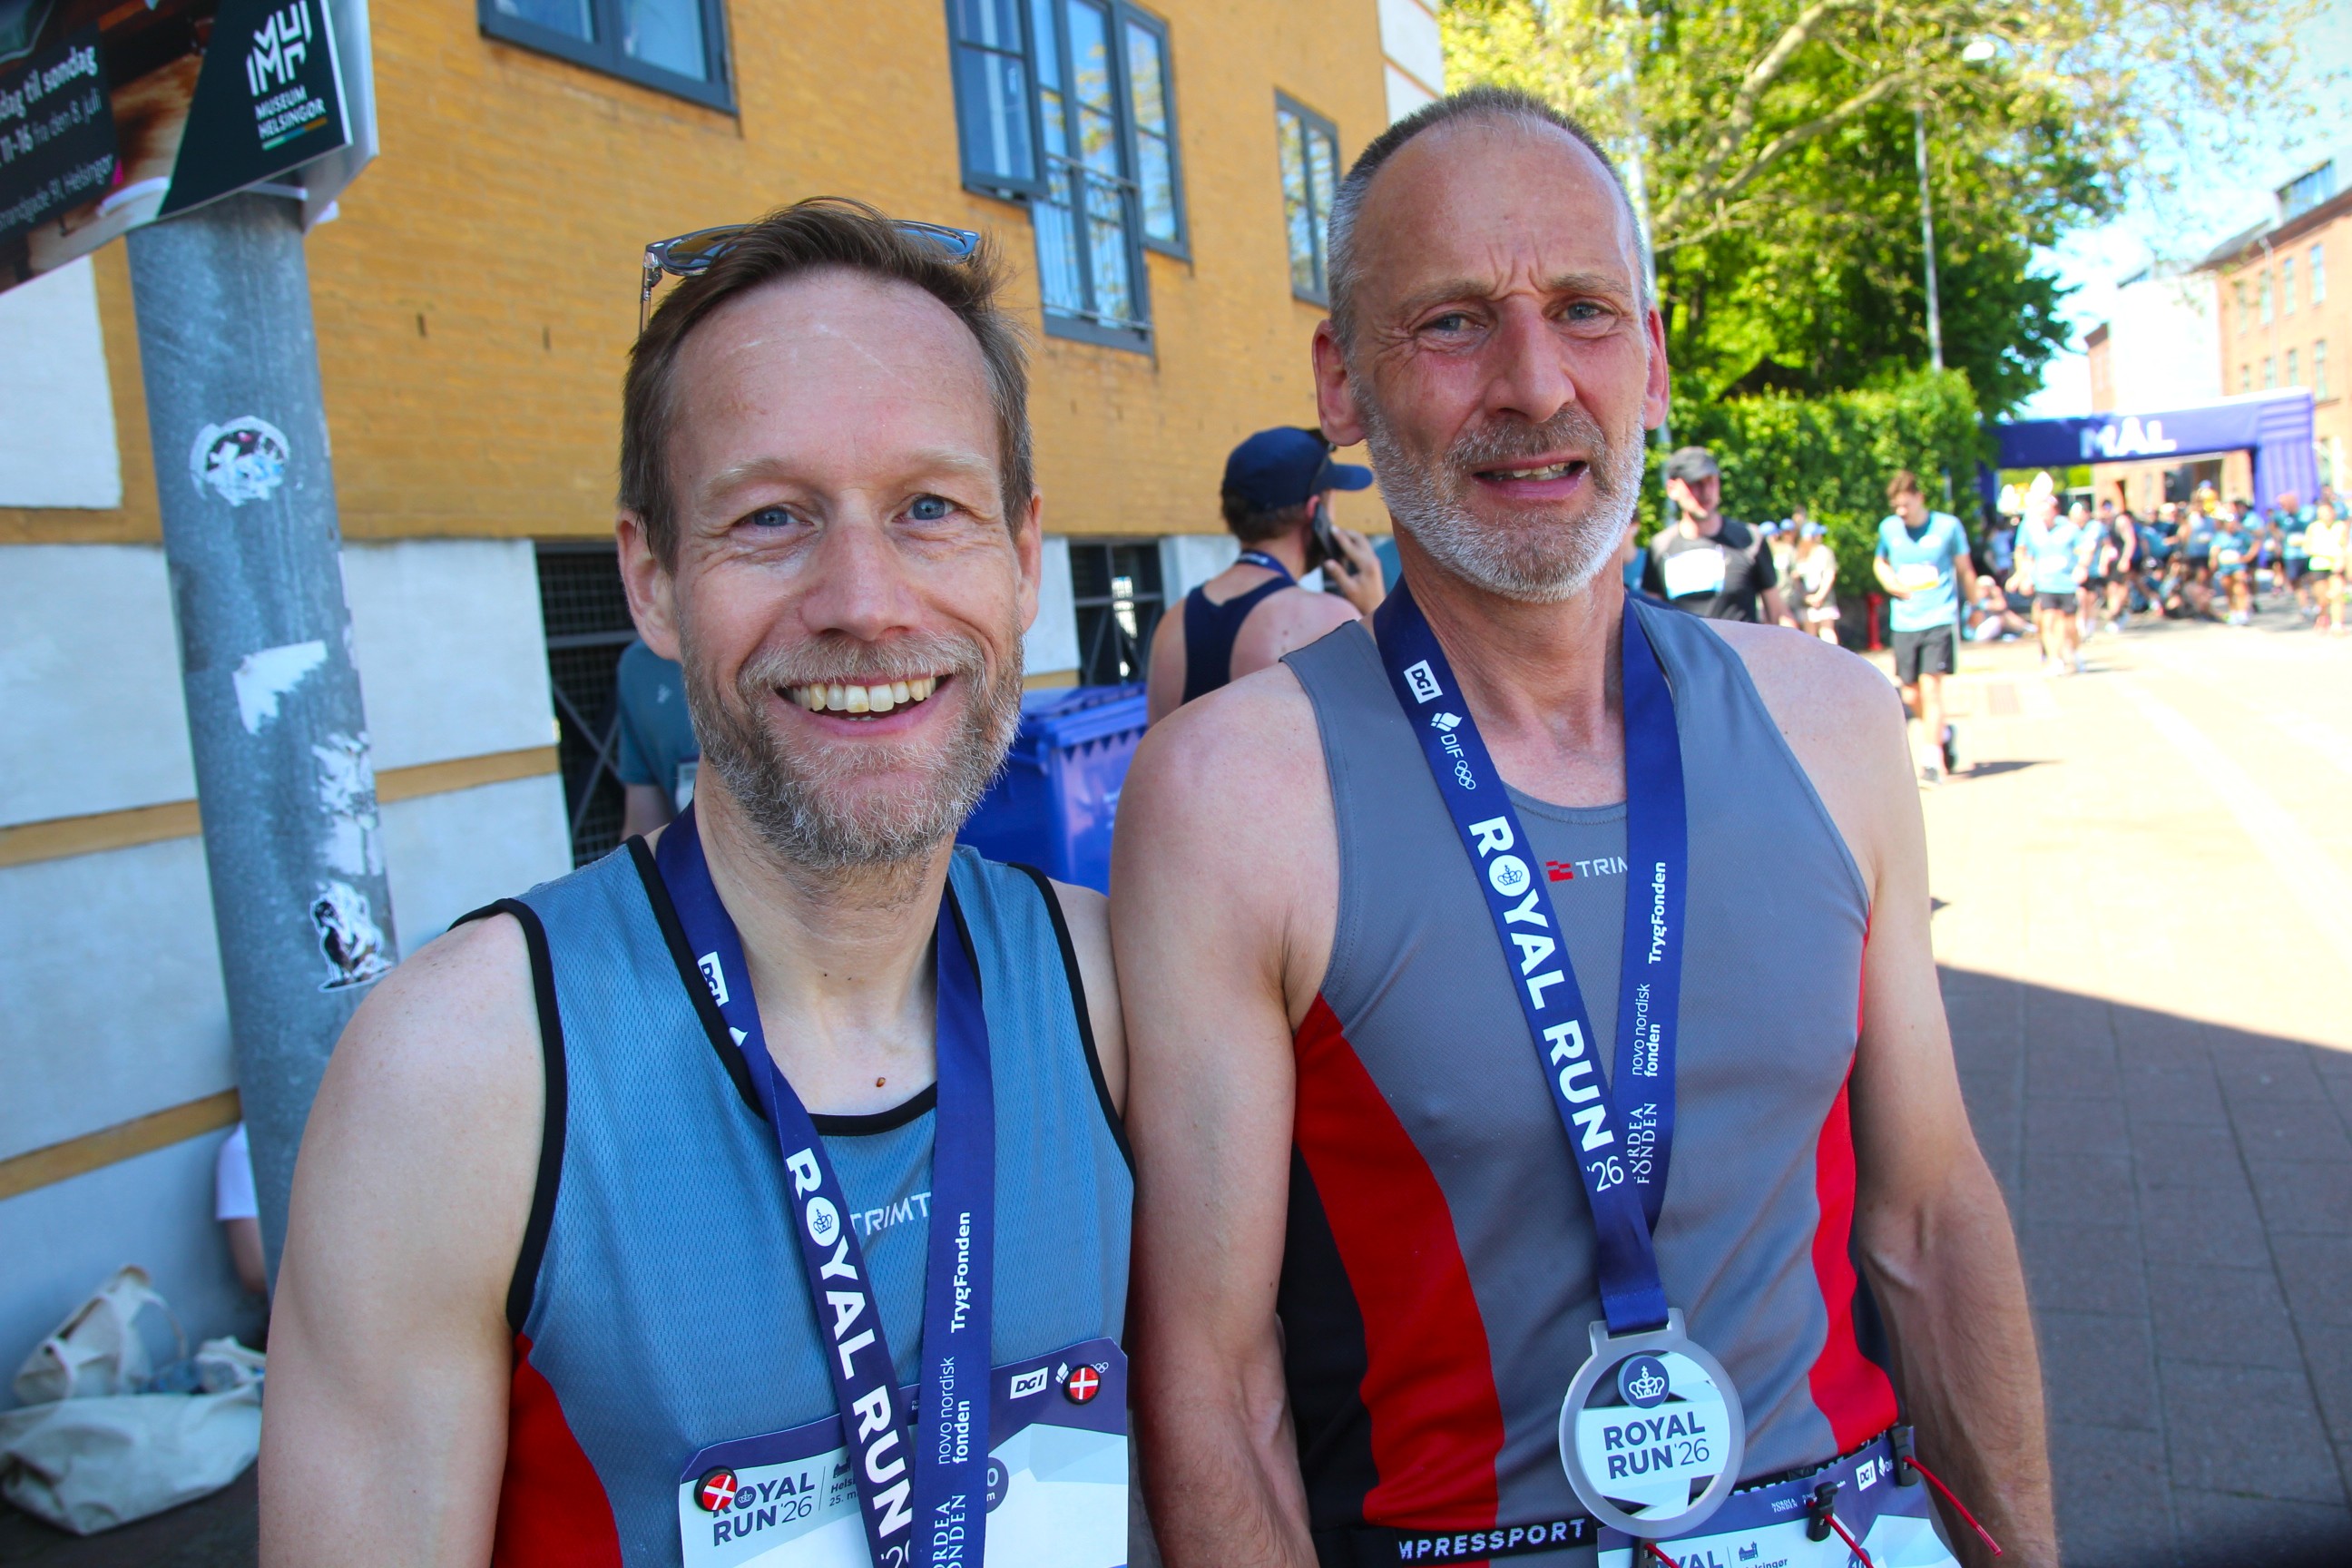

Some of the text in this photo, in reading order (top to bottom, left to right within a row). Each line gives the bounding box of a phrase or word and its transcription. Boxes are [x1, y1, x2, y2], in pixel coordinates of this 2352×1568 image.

[24, 70, 43, 103] til
[43, 46, 98, 93] søndag
[255, 85, 307, 121] MUSEUM
[258, 98, 326, 139] HELSINGØR
[1411, 668, 1435, 696] DGI
[1441, 734, 1464, 759] DIF
[1649, 861, 1667, 964] TrygFonden
[1468, 816, 1565, 1010] ROYAL
[1543, 1019, 1614, 1152] RUN
[1632, 984, 1651, 1075] novo nordisk
[1644, 1023, 1661, 1077] fonden
[951, 1211, 972, 1333] TrygFonden
[785, 1148, 876, 1380] ROYAL
[852, 1385, 912, 1538] RUN
[938, 1356, 955, 1465] novo nordisk
[1014, 1375, 1044, 1393] DGI
[953, 1400, 970, 1464] fonden
[1602, 1411, 1705, 1451] ROYAL
[1860, 1465, 1874, 1485] DGI
